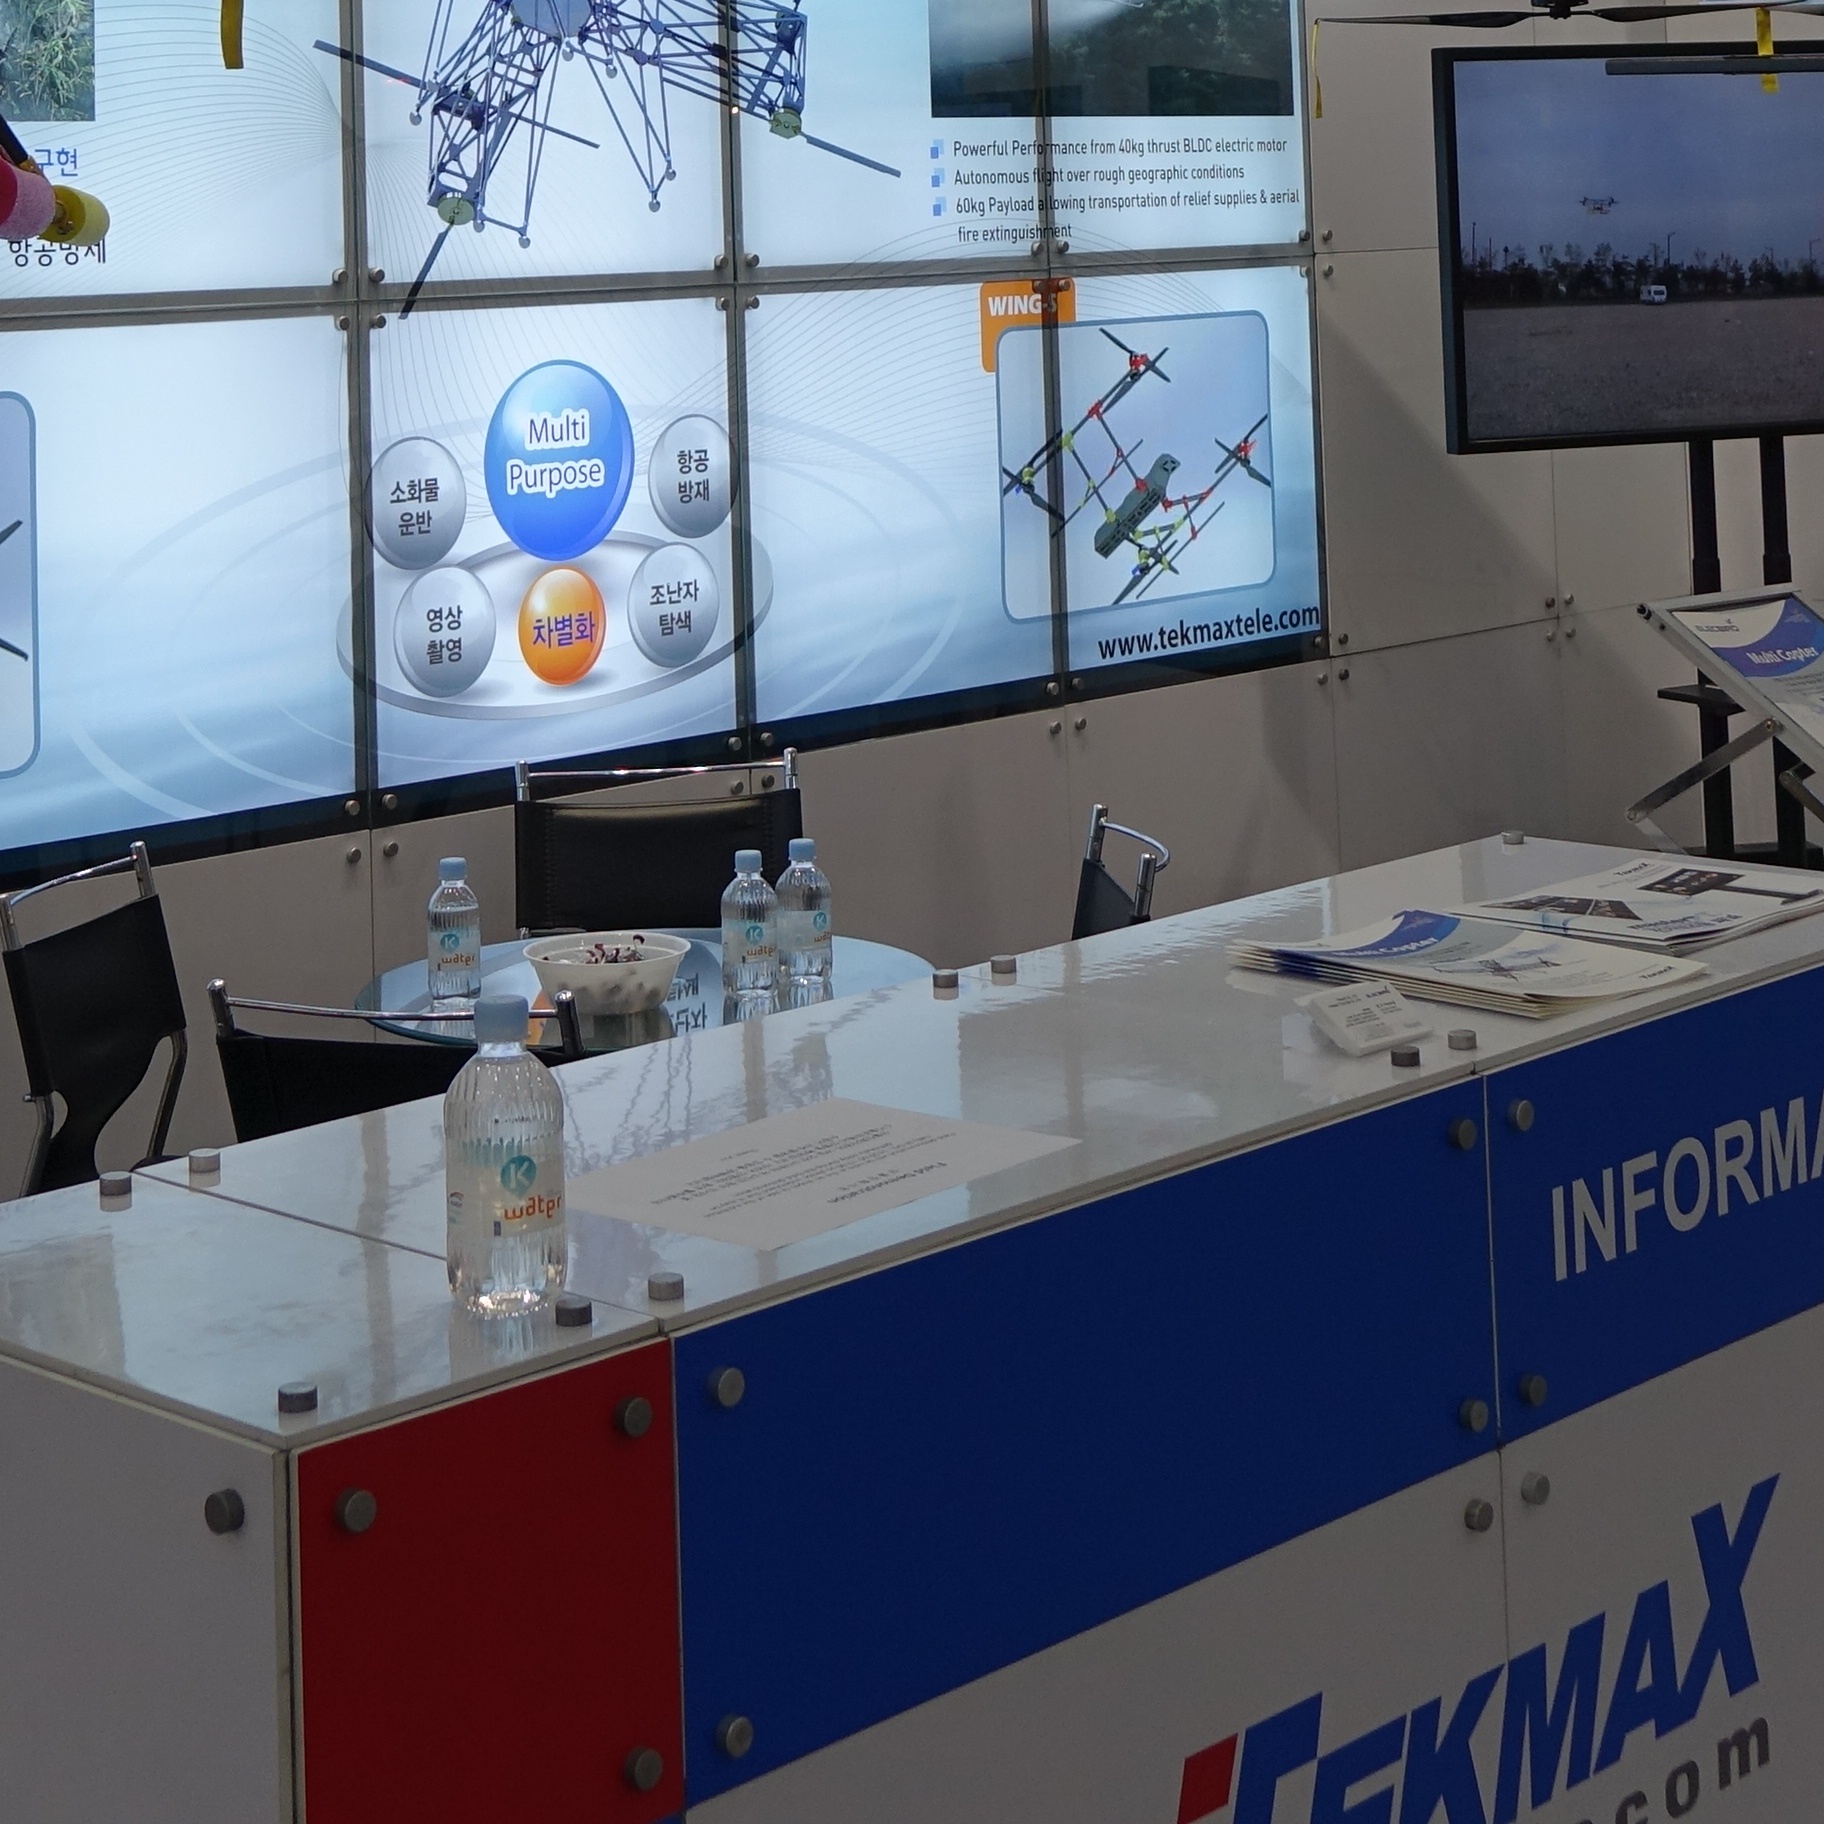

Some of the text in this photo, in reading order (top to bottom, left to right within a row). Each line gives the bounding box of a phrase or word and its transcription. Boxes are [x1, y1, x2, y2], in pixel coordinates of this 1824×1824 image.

[953, 137, 1288, 158] Powerful Performance from 40kg thrust BLDC electric motor
[954, 164, 1245, 186] Autonomous flight over rough geographic conditions
[956, 197, 986, 217] 60kg
[989, 196, 1035, 217] Payload
[1088, 191, 1168, 212] transportation
[1170, 191, 1181, 207] of
[1183, 190, 1212, 206] relief
[1214, 190, 1258, 209] supplies
[1259, 189, 1268, 204] &
[1270, 188, 1300, 204] aerial
[958, 223, 1073, 245] fire extinguishment
[529, 414, 587, 445] Multi
[677, 449, 710, 475] 항공
[389, 477, 440, 505] 소화물
[509, 460, 602, 495] Purpose
[677, 479, 711, 505] 방재
[398, 510, 433, 537] 운반
[650, 579, 700, 607] 조난자
[426, 605, 464, 635] 영상
[532, 611, 596, 650] 차별화
[659, 610, 694, 637] 탐색
[1097, 602, 1321, 662] www.tekmaxtele.com
[426, 635, 464, 666] 촬영
[1778, 645, 1821, 663] Copter
[503, 1194, 563, 1220] water
[1178, 1472, 1781, 1824] TEKMAX
